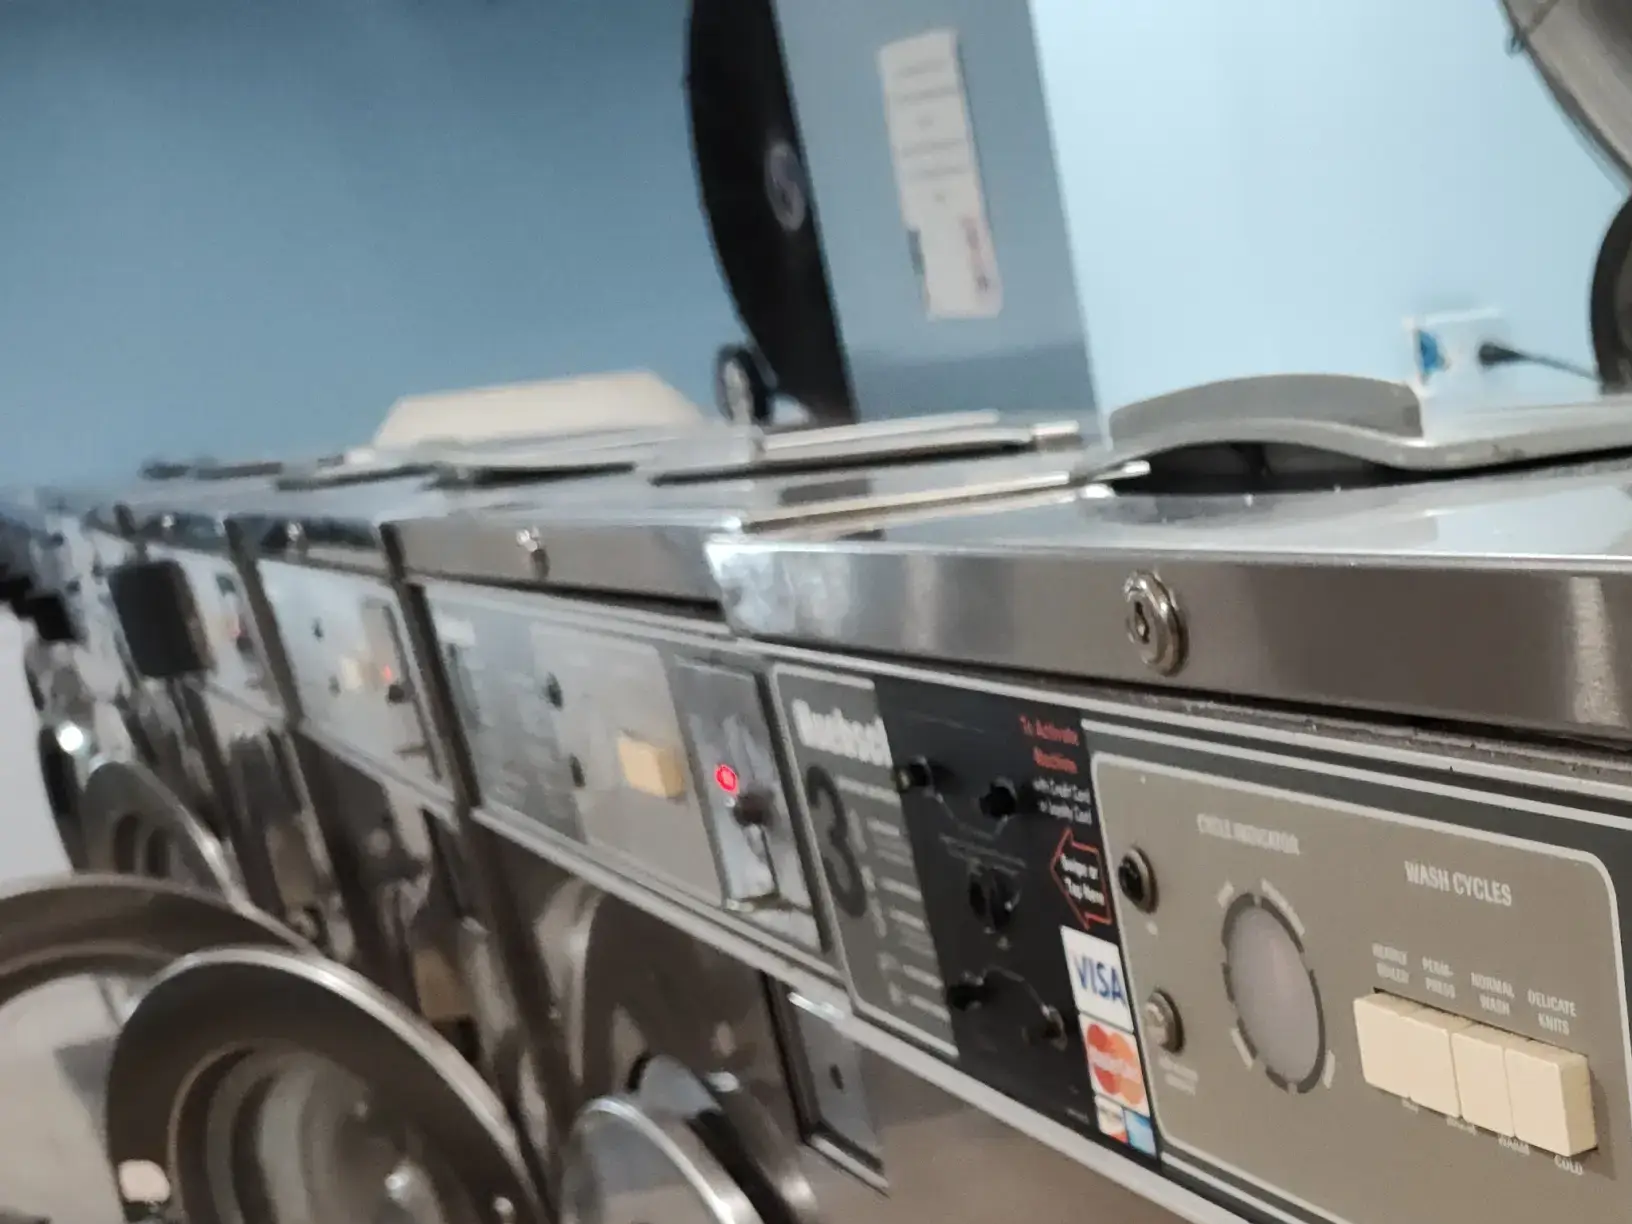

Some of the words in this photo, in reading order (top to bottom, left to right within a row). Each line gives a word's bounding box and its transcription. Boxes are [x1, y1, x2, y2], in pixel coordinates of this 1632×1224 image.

[1404, 860, 1450, 892] WASH
[1452, 871, 1513, 907] CYCLES
[1074, 954, 1127, 1006] VISA
[1470, 971, 1515, 1000] NORMAL
[1479, 993, 1510, 1017] WASH
[1527, 988, 1577, 1018] DELICATE
[1537, 1012, 1570, 1037] KNITS
[1553, 1154, 1584, 1176] COLD
